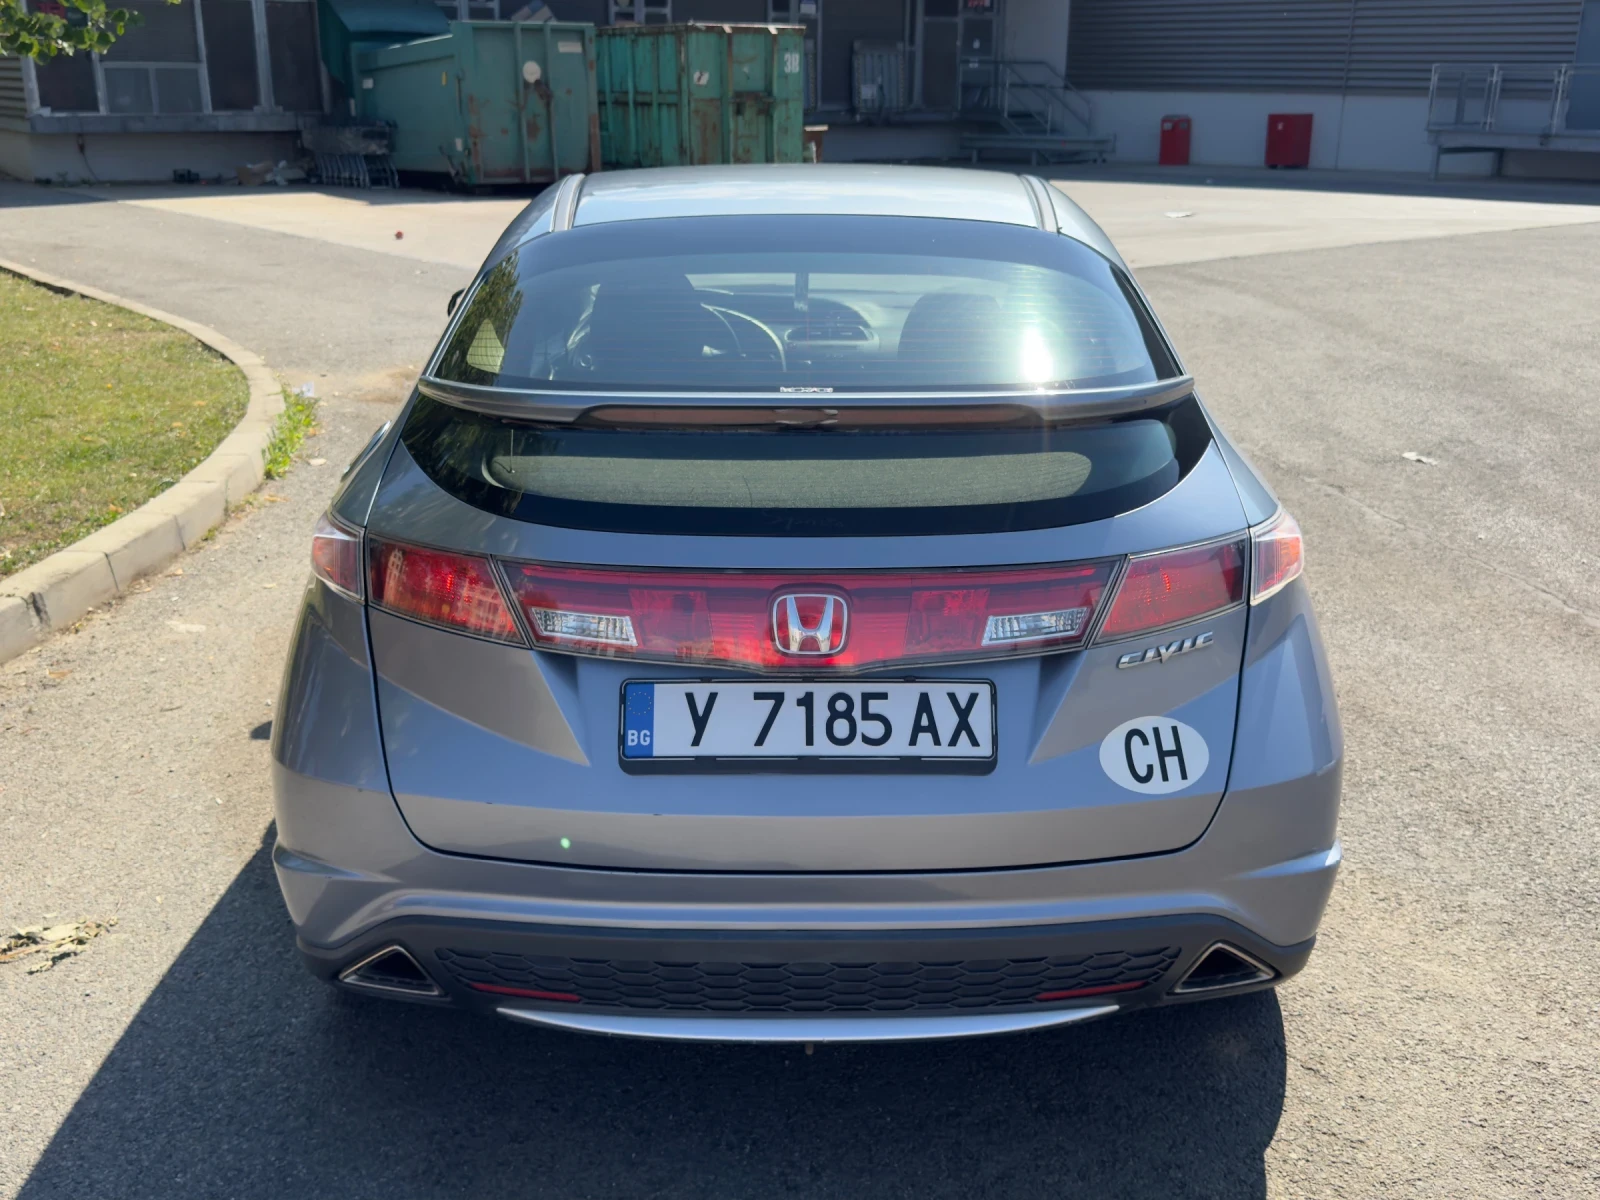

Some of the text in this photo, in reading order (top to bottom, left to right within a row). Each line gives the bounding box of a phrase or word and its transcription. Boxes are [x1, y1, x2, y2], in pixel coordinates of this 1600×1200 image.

[1116, 631, 1214, 669] CIVIC
[626, 729, 651, 746] BG
[753, 691, 893, 747] 7185
[908, 691, 981, 747] AX
[1124, 725, 1188, 784] CH
